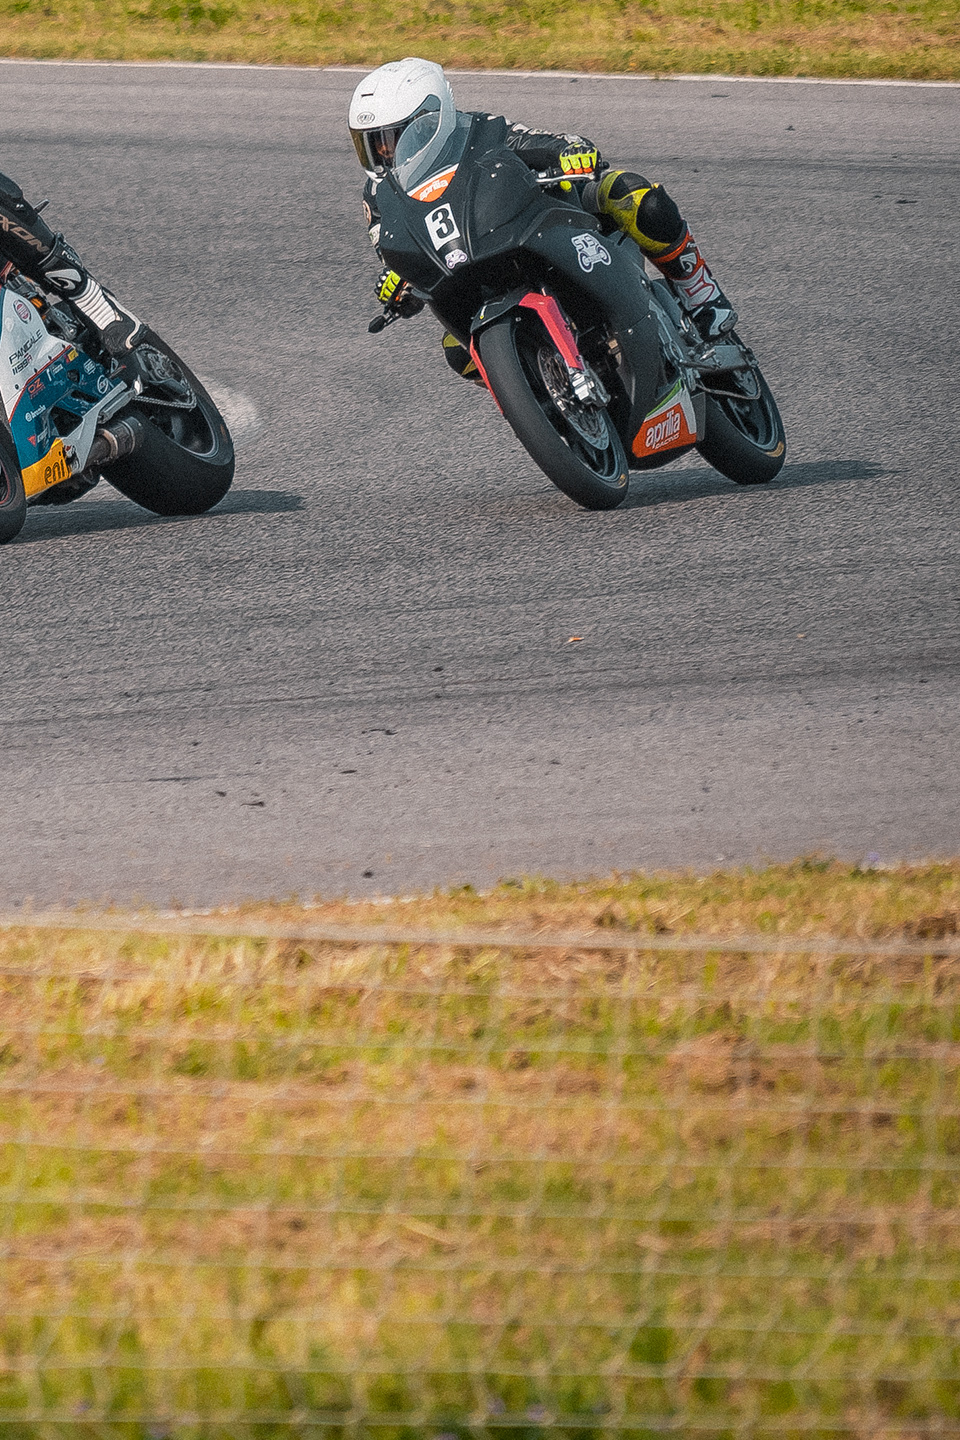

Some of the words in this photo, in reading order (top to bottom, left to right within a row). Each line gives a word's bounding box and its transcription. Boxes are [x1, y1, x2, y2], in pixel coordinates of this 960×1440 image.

[431, 207, 455, 239] 3
[645, 409, 681, 449] aprilia
[44, 450, 65, 485] eni
